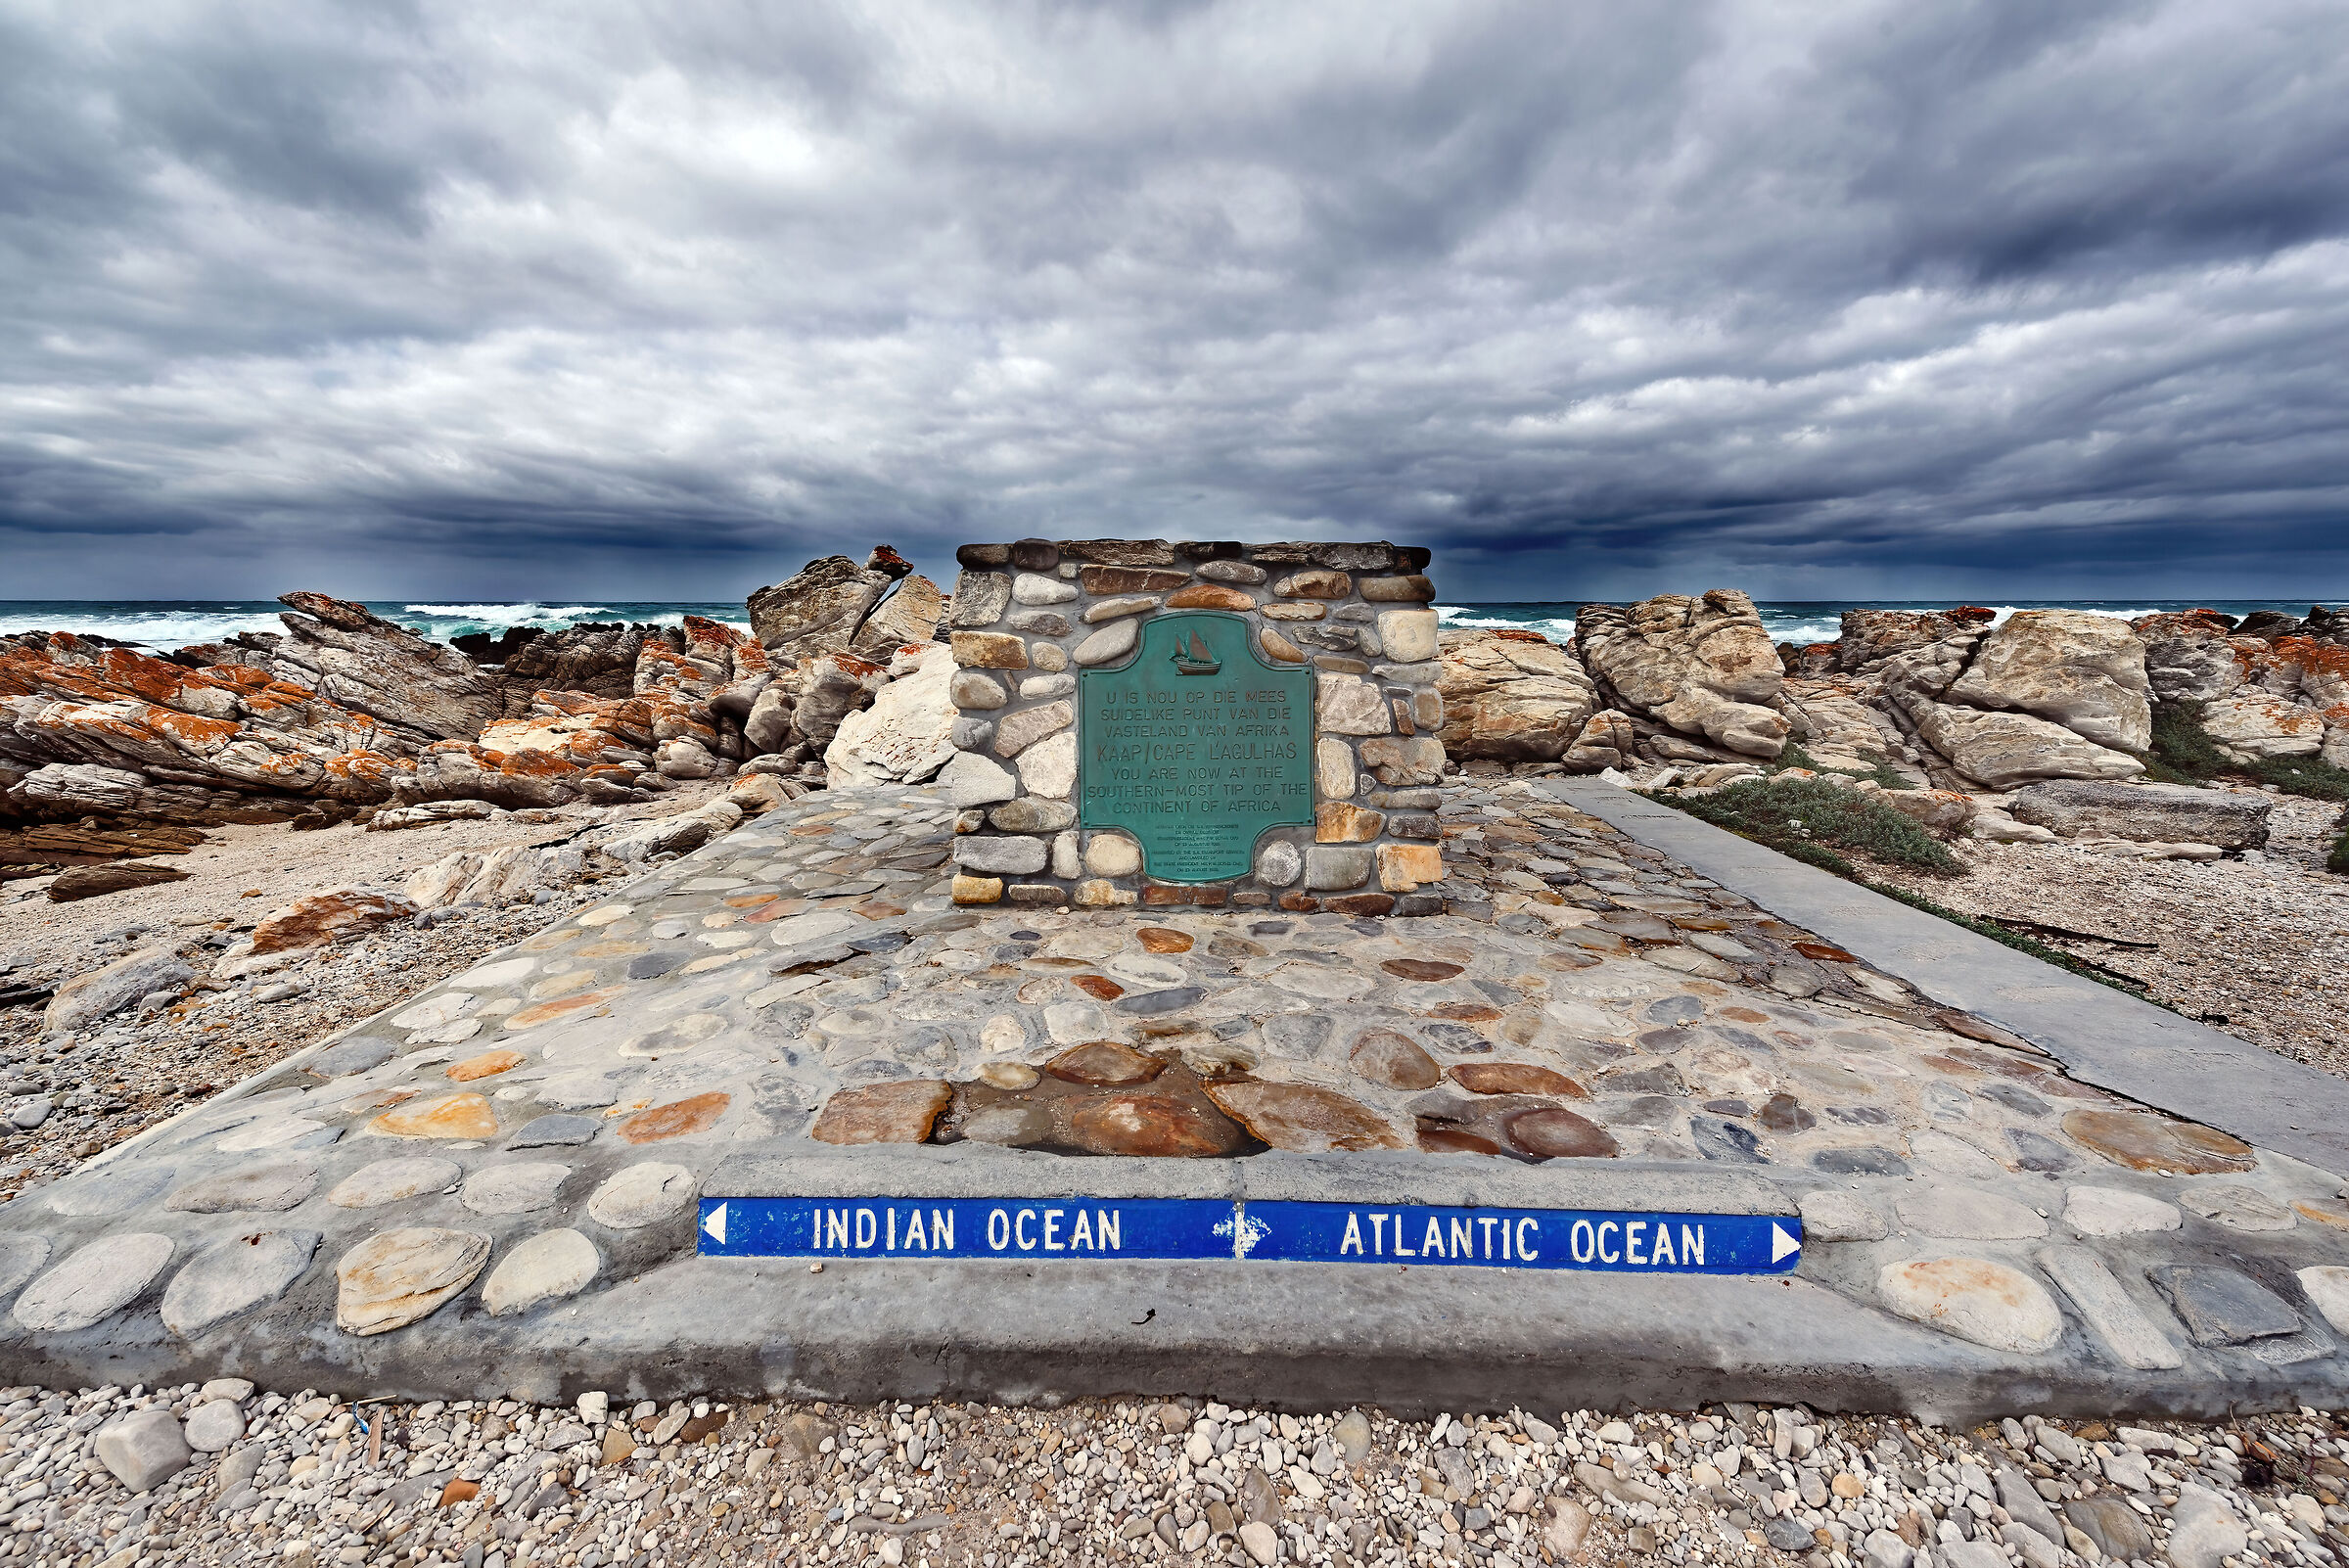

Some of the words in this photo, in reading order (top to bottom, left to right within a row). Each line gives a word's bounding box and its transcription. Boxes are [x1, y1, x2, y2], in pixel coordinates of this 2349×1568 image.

[1107, 692, 1116, 704] U
[1125, 692, 1137, 704] IS
[1146, 691, 1176, 704] NOU
[1186, 692, 1205, 703] OP
[1214, 691, 1236, 703] DIE
[1246, 690, 1285, 703] MEES
[1101, 708, 1174, 720] SUIDELIKE
[1183, 708, 1220, 720] PUNT
[1229, 708, 1259, 718] VAN
[1267, 708, 1291, 719] DIE
[1105, 725, 1187, 737] VASTELAND
[1198, 725, 1225, 736] VAN
[1236, 725, 1289, 736] AFRIKA
[1097, 741, 1196, 763] KAAP/CAPE
[1210, 741, 1297, 760] L'AGULHAS
[1112, 768, 1140, 780] YOU
[1149, 768, 1177, 779] ARE
[1188, 767, 1221, 778] NOW
[1229, 767, 1251, 778] AT
[1256, 766, 1283, 778] THE
[1088, 784, 1214, 798] SOUTHERN-MOST
[1223, 785, 1244, 796] TIP
[1253, 784, 1270, 796] OF
[1281, 783, 1307, 795] THE
[1113, 801, 1192, 813] CONTINENT
[1201, 801, 1218, 812] OF
[1228, 801, 1280, 811] AFRICA
[813, 1208, 955, 1251] INDIAN
[988, 1208, 1121, 1251] OCEAN
[1340, 1213, 1540, 1262] ATLANTIC
[1571, 1219, 1707, 1267] OCEAN
